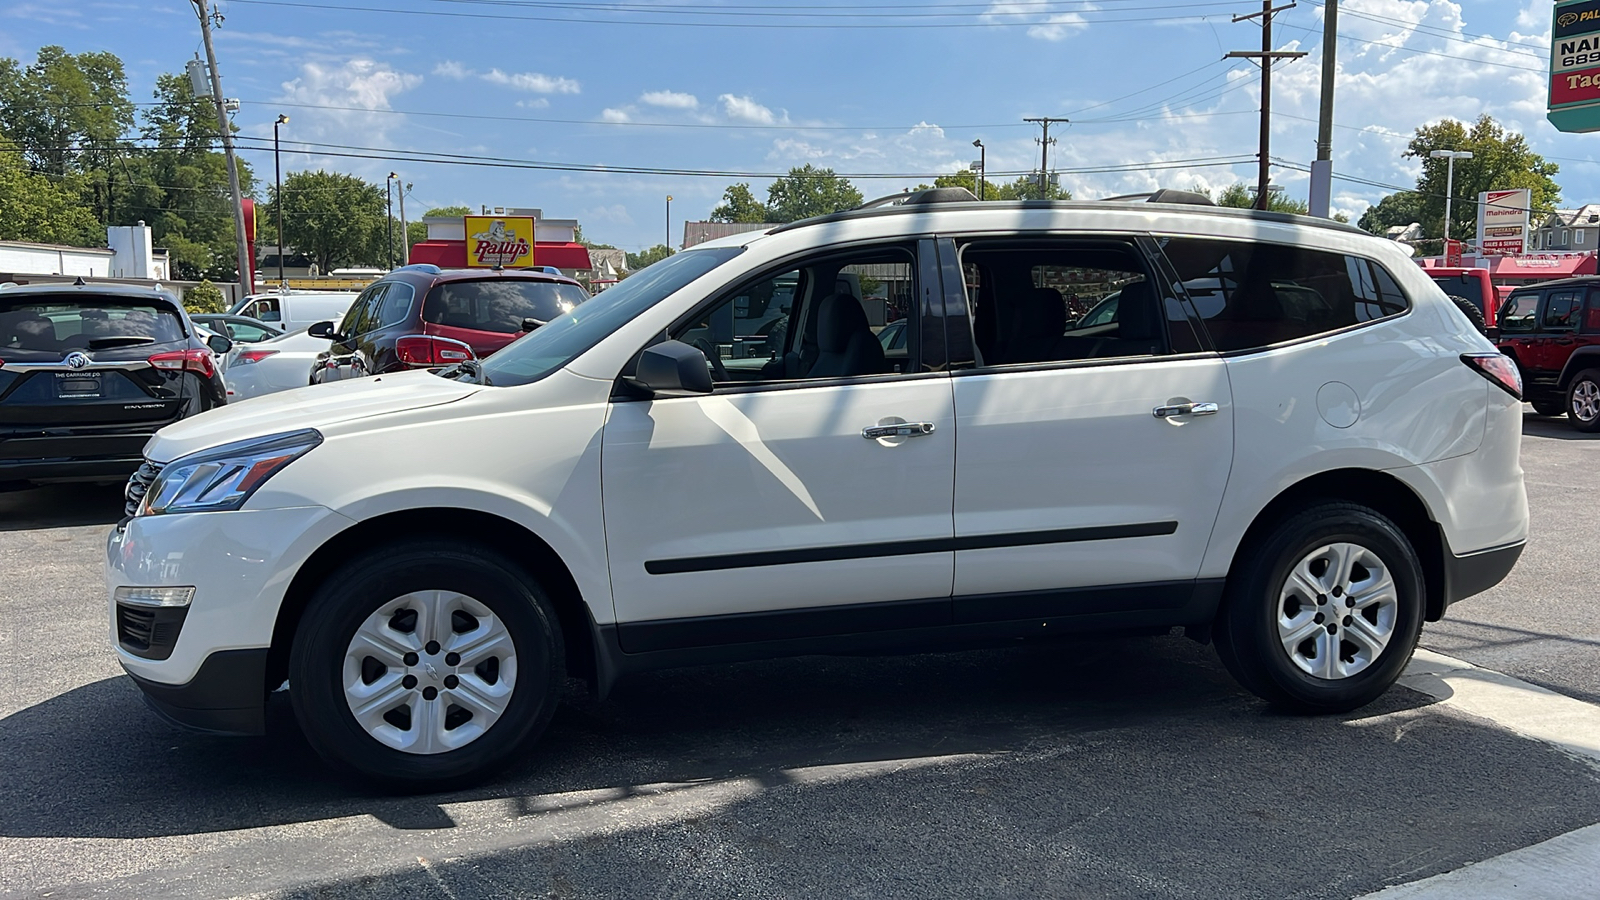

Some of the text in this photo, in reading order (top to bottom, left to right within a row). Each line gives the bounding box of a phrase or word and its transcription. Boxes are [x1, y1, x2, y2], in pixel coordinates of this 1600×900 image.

[1561, 37, 1599, 55] NAI
[1562, 52, 1600, 66] 689
[473, 238, 529, 262] Rally's
